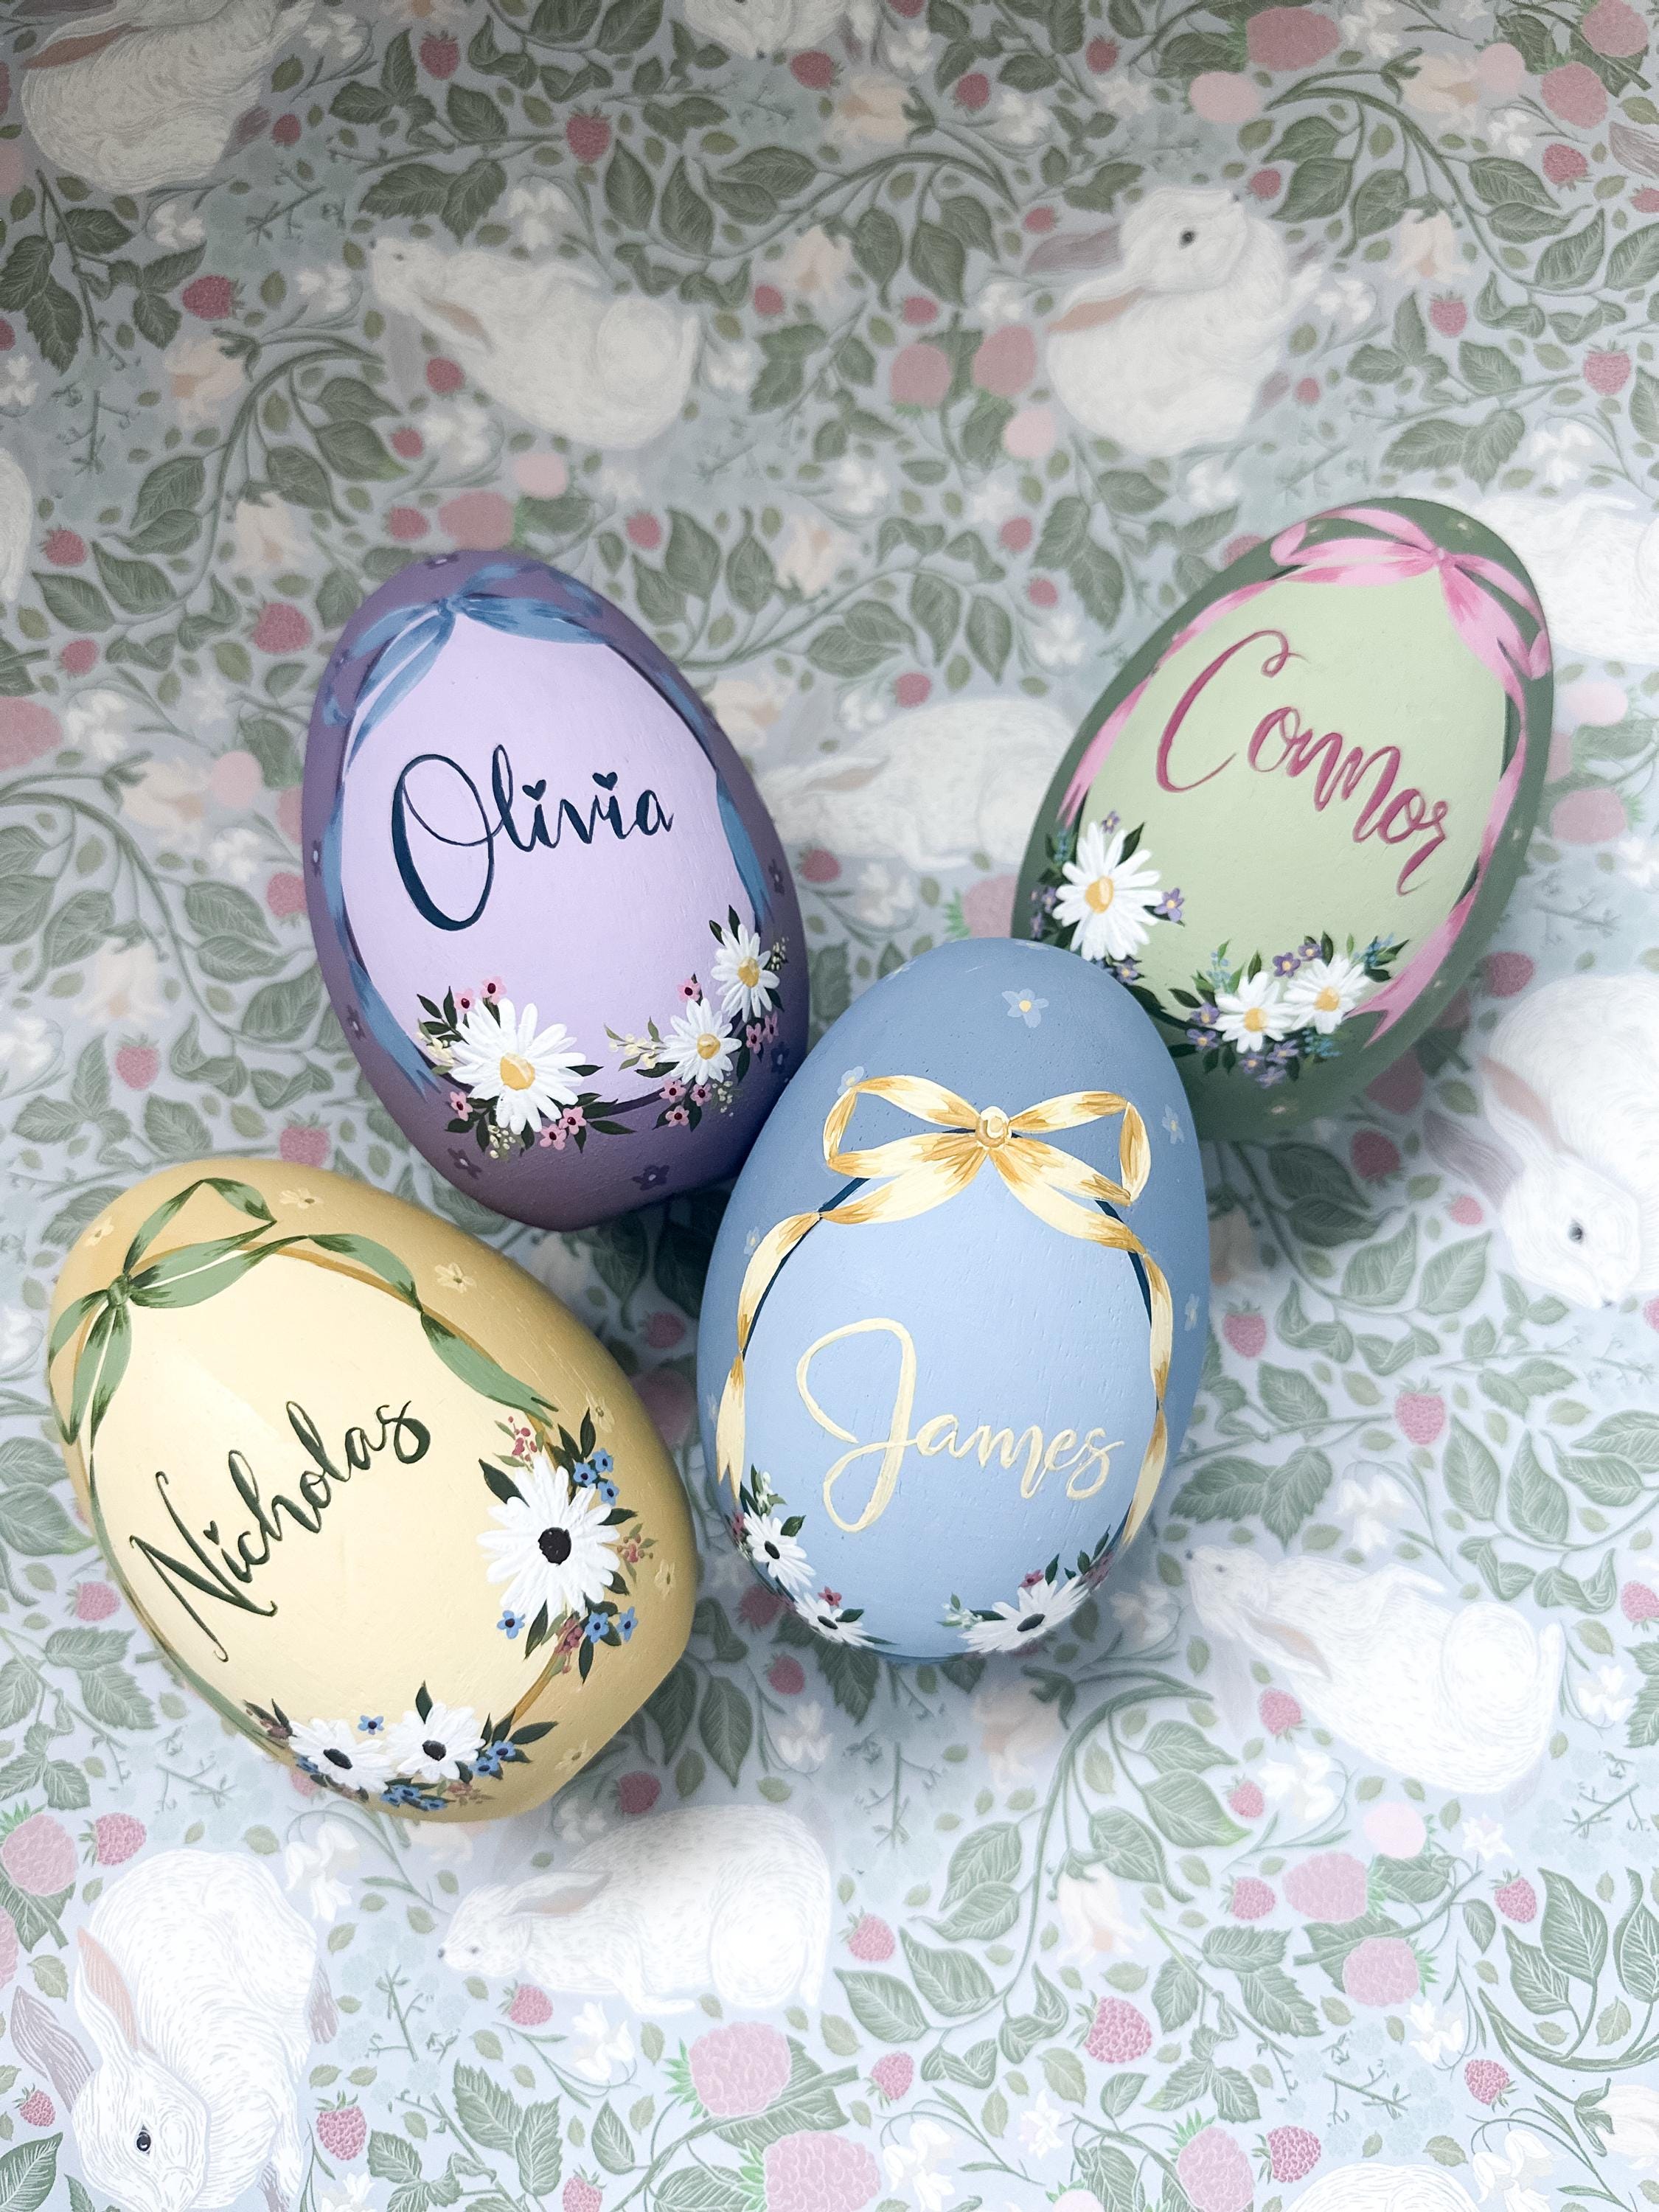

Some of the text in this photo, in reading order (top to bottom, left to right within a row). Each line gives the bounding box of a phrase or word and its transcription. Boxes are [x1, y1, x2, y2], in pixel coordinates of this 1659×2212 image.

[391, 743, 675, 932] Olivia
[1155, 629, 1450, 897] Connor
[128, 1400, 431, 1663] Nicholas
[796, 1317, 1125, 1534] James
